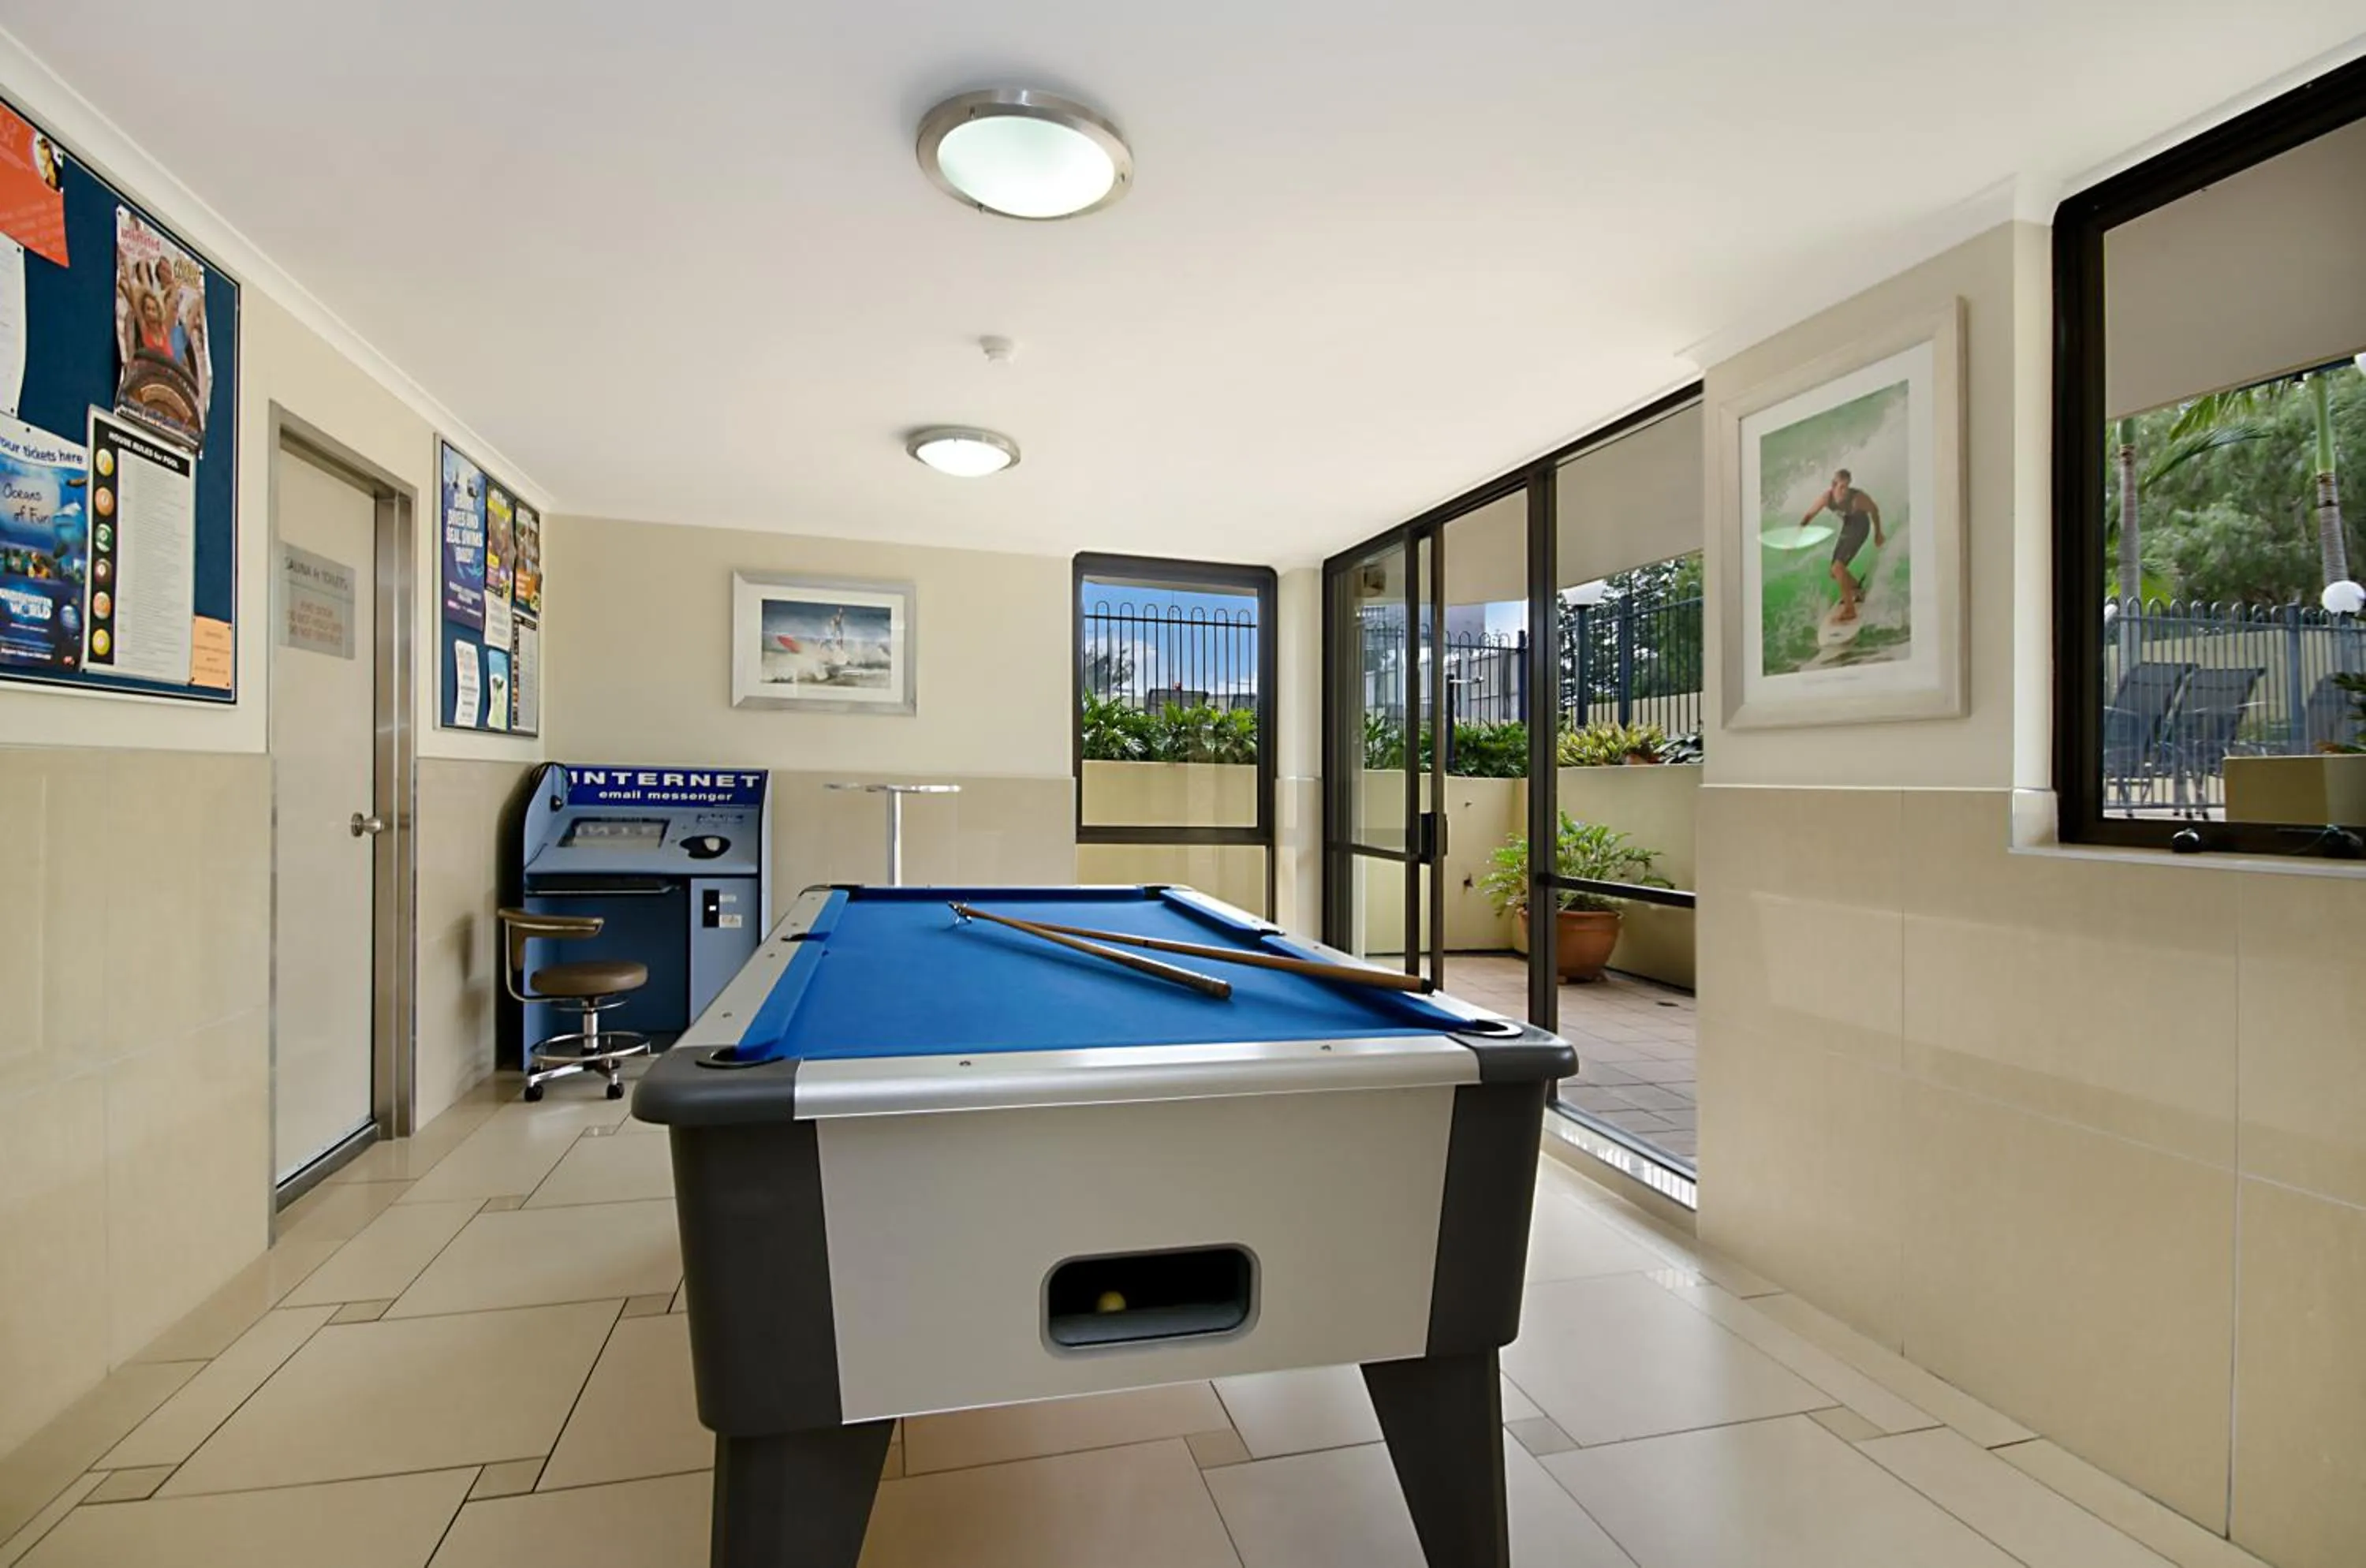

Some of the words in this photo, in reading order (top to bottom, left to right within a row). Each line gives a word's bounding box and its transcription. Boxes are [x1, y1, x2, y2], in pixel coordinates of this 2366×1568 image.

[23, 442, 57, 462] tickets
[58, 448, 83, 465] here
[3, 482, 43, 501] Oceans
[13, 505, 26, 521] of
[29, 506, 50, 525] Fun
[569, 771, 759, 788] INTERNET
[599, 790, 641, 800] email
[647, 791, 733, 802] messenger
